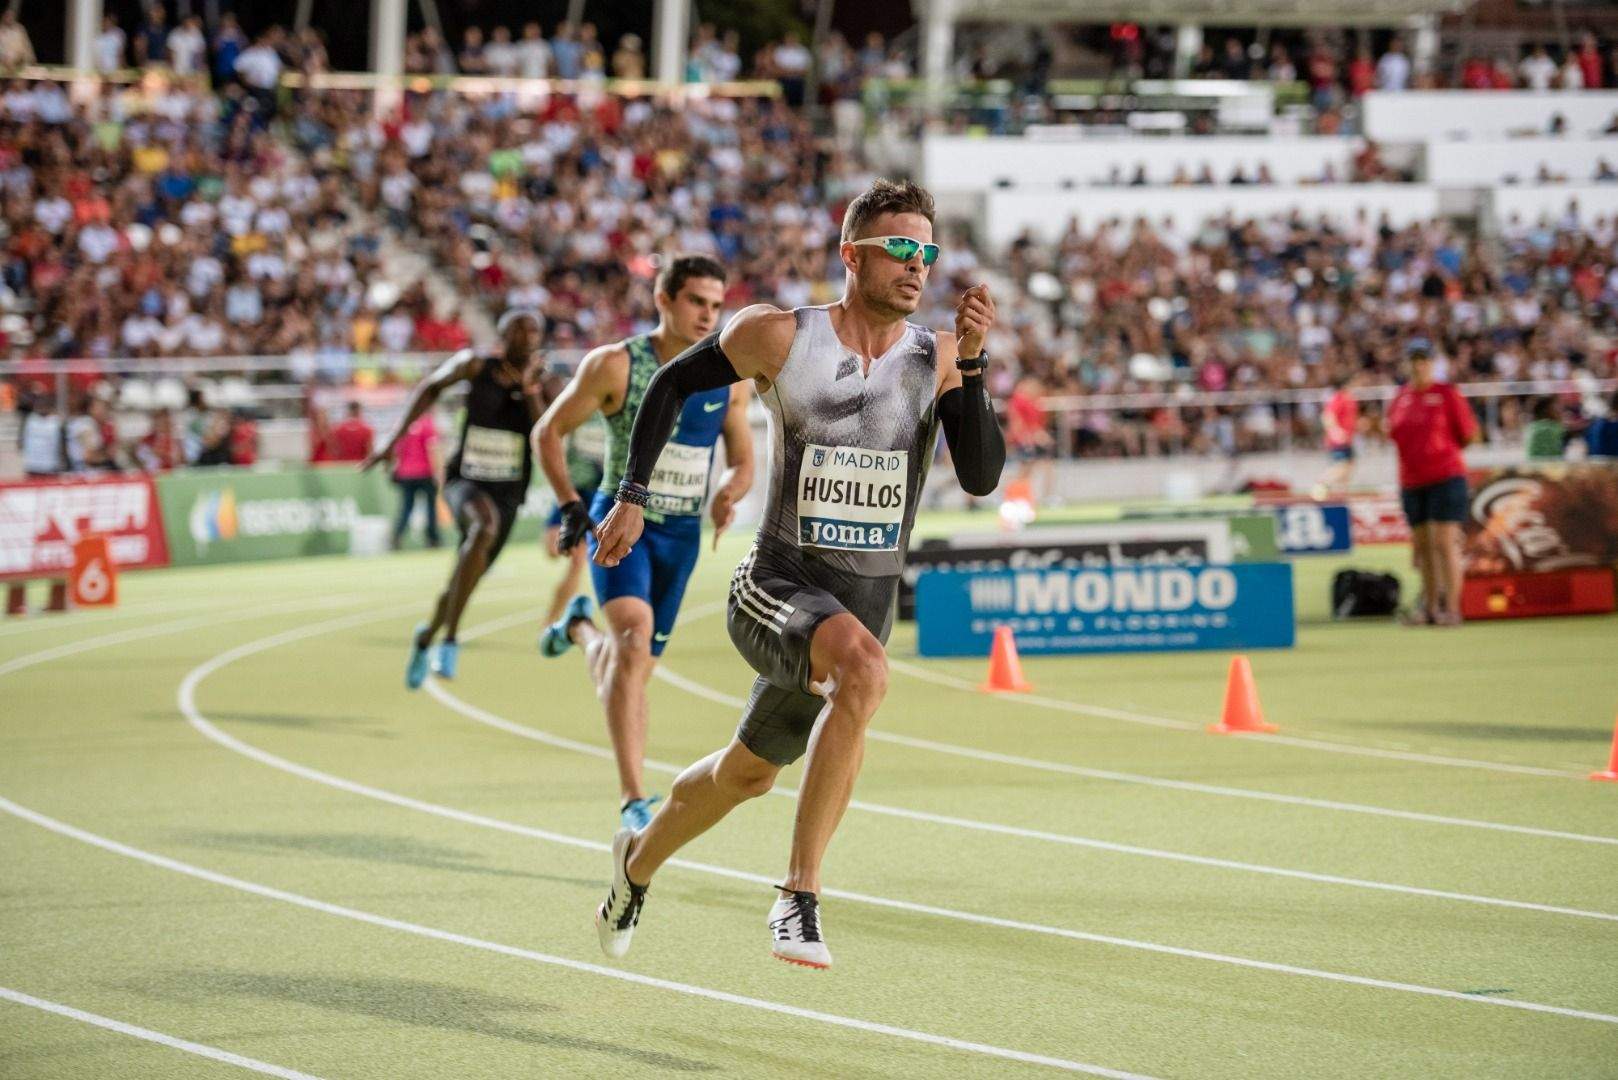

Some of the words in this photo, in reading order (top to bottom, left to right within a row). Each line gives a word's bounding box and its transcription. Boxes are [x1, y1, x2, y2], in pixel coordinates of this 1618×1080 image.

[833, 451, 900, 471] MADRID
[803, 477, 902, 509] HUSILLOS
[78, 557, 110, 602] 6
[1015, 568, 1237, 614] MONDO
